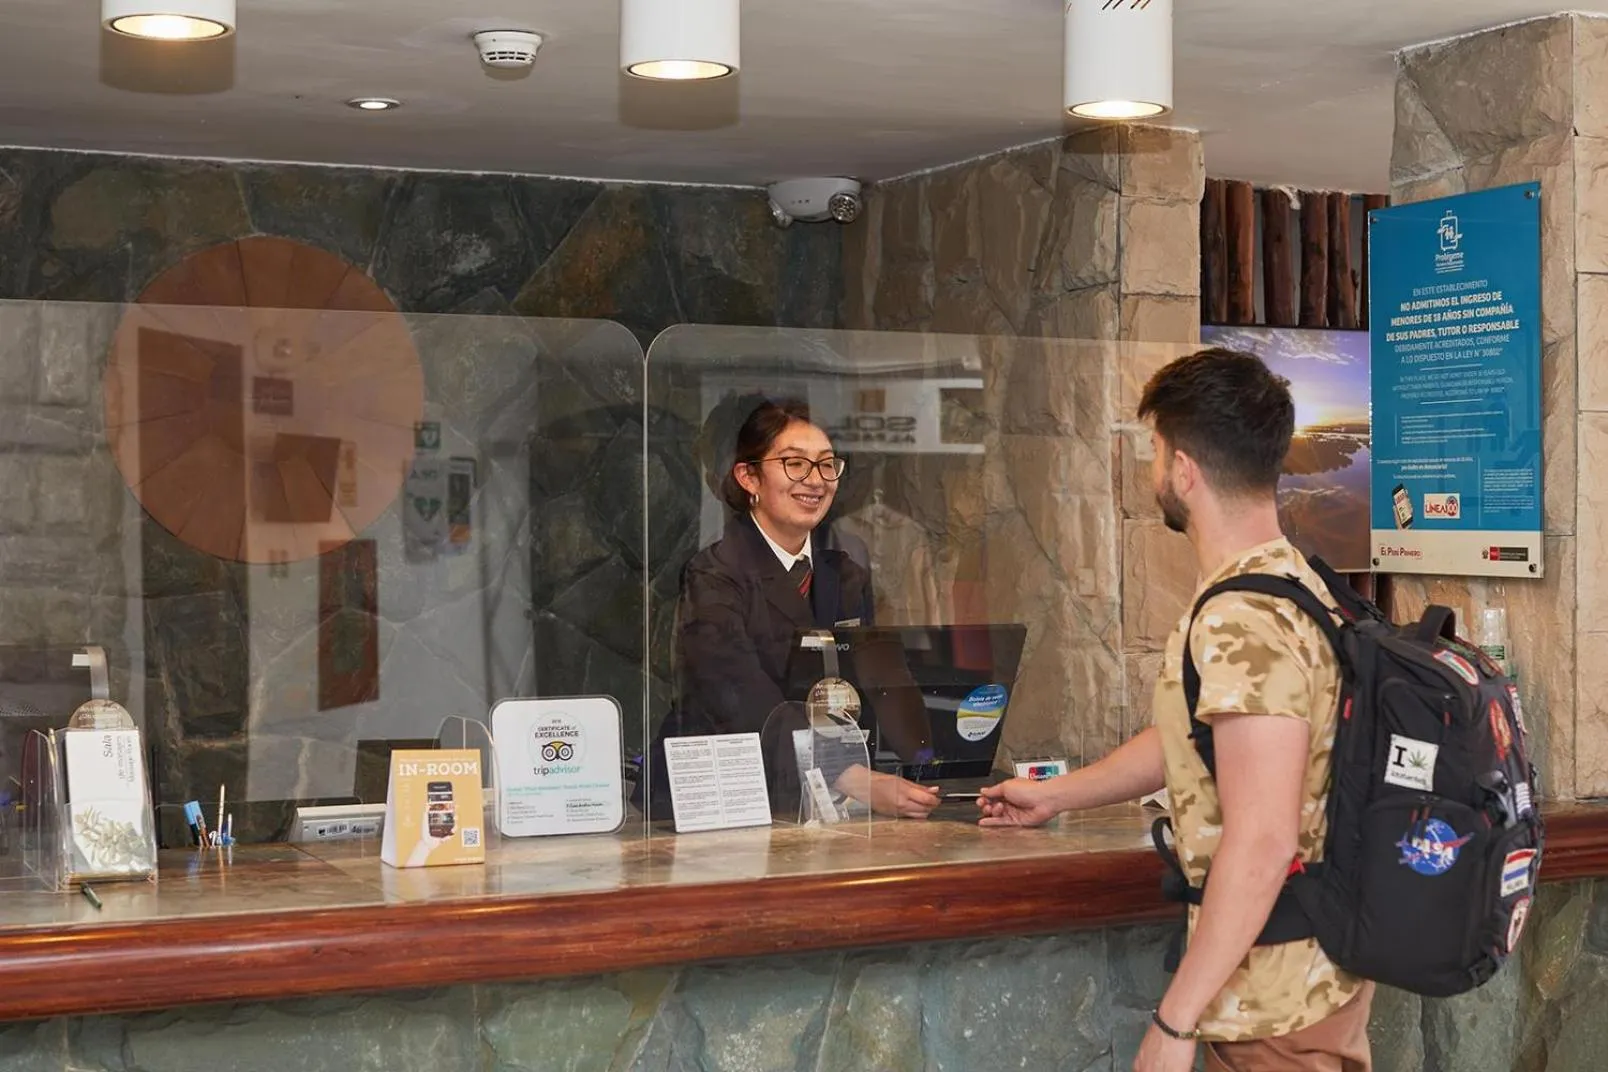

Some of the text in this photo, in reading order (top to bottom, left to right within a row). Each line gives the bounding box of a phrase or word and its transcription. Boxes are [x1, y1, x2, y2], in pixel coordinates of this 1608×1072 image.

[1413, 280, 1488, 296] EN ESTE ESTABLECIMIENTO
[1400, 291, 1503, 312] NO ADMITIMOS EL INGRESO DE
[1391, 302, 1514, 327] MENORES DE 18 AÑOS SIN COMPAÑÍA
[1386, 319, 1520, 342] DE SUS PADRES, TUTOR O RESPONSABLE
[1395, 334, 1510, 353] DEBIDAMENTE ACREDITADOS, CONFORME
[1406, 355, 1414, 364] LO
[1414, 352, 1444, 363] DISPUESTO
[1445, 351, 1453, 360] EN
[1454, 350, 1462, 359] LA
[1462, 349, 1473, 358] LEY
[534, 730, 579, 739] EXCELLENCE
[1392, 745, 1407, 768] I
[398, 762, 478, 776] IN-ROOM
[533, 764, 581, 776] tripadvisor
